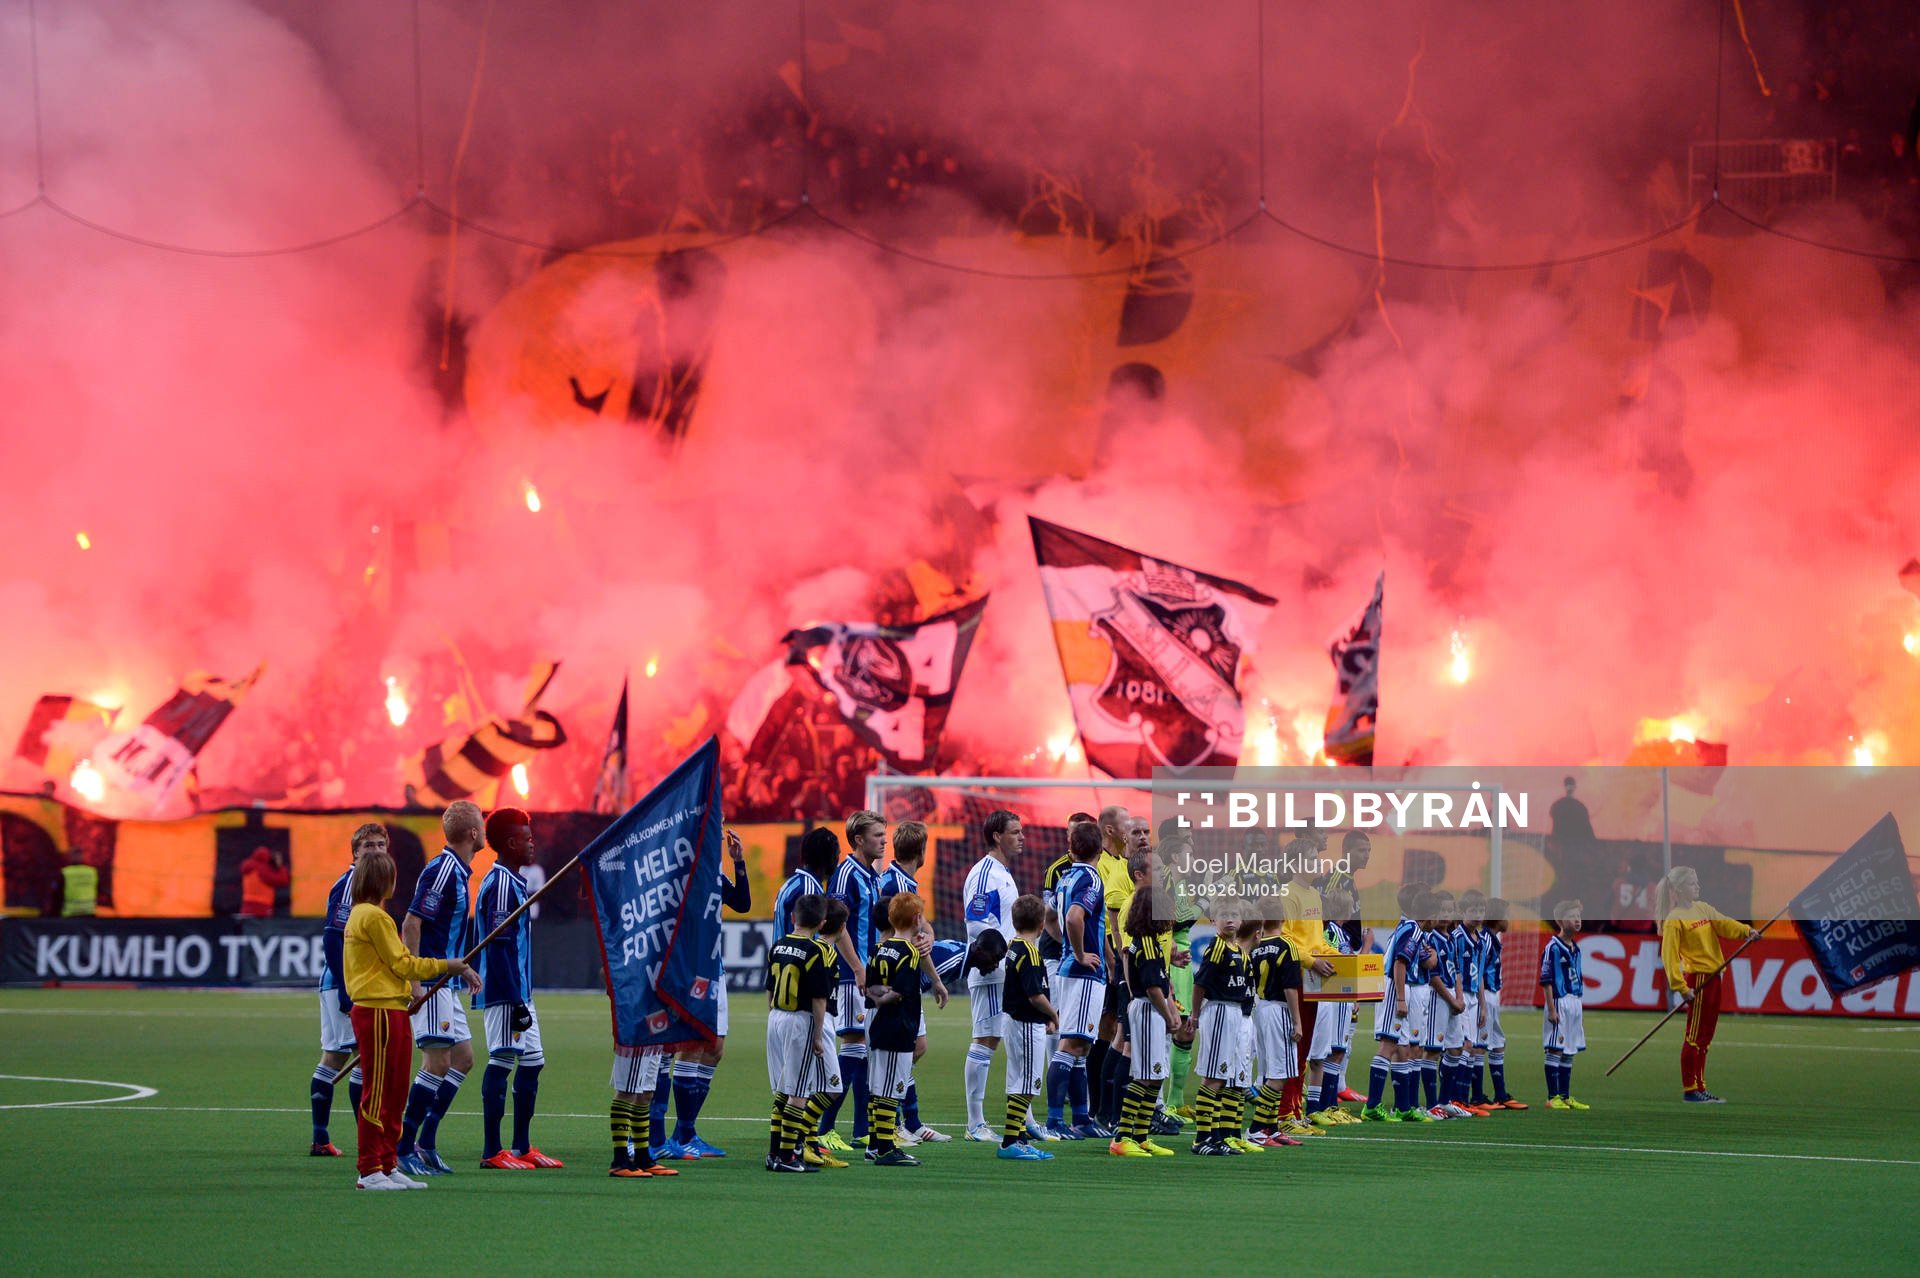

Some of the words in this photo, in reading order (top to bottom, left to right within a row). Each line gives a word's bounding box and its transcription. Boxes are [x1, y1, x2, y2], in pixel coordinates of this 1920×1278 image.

[634, 837, 696, 887] HELA
[1828, 868, 1876, 904] HELA
[621, 873, 687, 932] SVERI
[1820, 876, 1904, 932] SVERIGES
[35, 934, 213, 978] KUMHO
[771, 962, 801, 1012] 10
